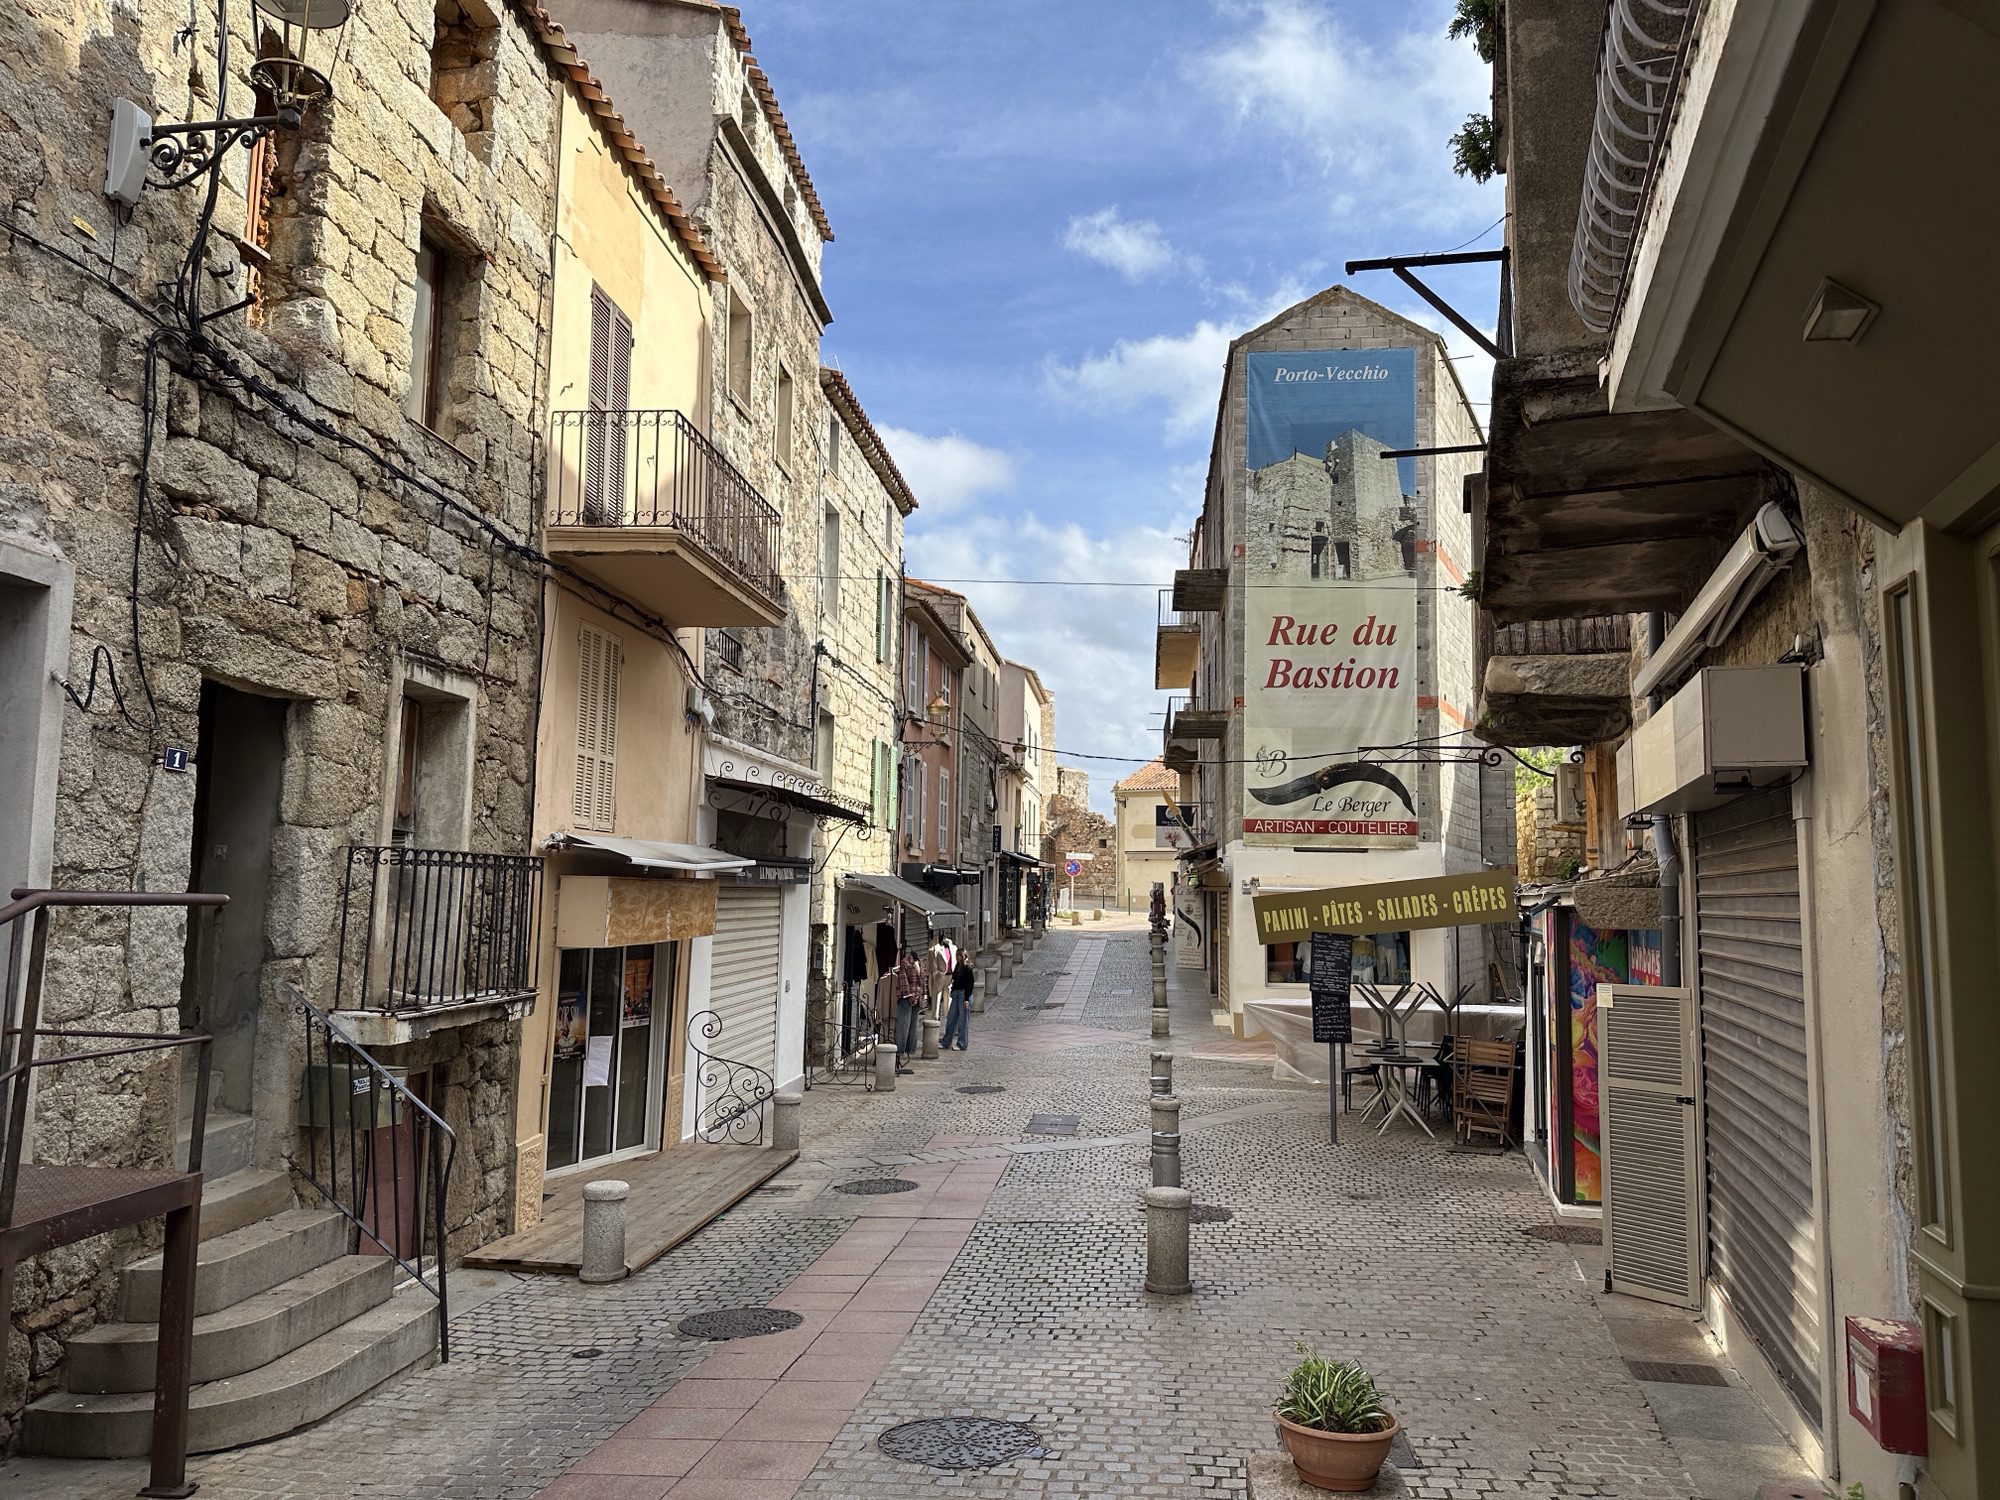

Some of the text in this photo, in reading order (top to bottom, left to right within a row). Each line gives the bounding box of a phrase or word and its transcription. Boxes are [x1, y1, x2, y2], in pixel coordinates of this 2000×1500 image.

[1273, 365, 1389, 382] Porto-Vecchio
[1266, 615, 1397, 646] Rue du
[1264, 658, 1399, 689] Bastion
[173, 752, 181, 767] 1
[1312, 796, 1391, 818] Le Berger
[1254, 820, 1316, 833] ARTISAN
[1328, 821, 1408, 835] COUTELIER
[1263, 907, 1310, 933] PANINI
[1321, 899, 1364, 927] PÂTES
[1376, 893, 1439, 922] SALADES
[1452, 885, 1508, 914] CRÊPES
